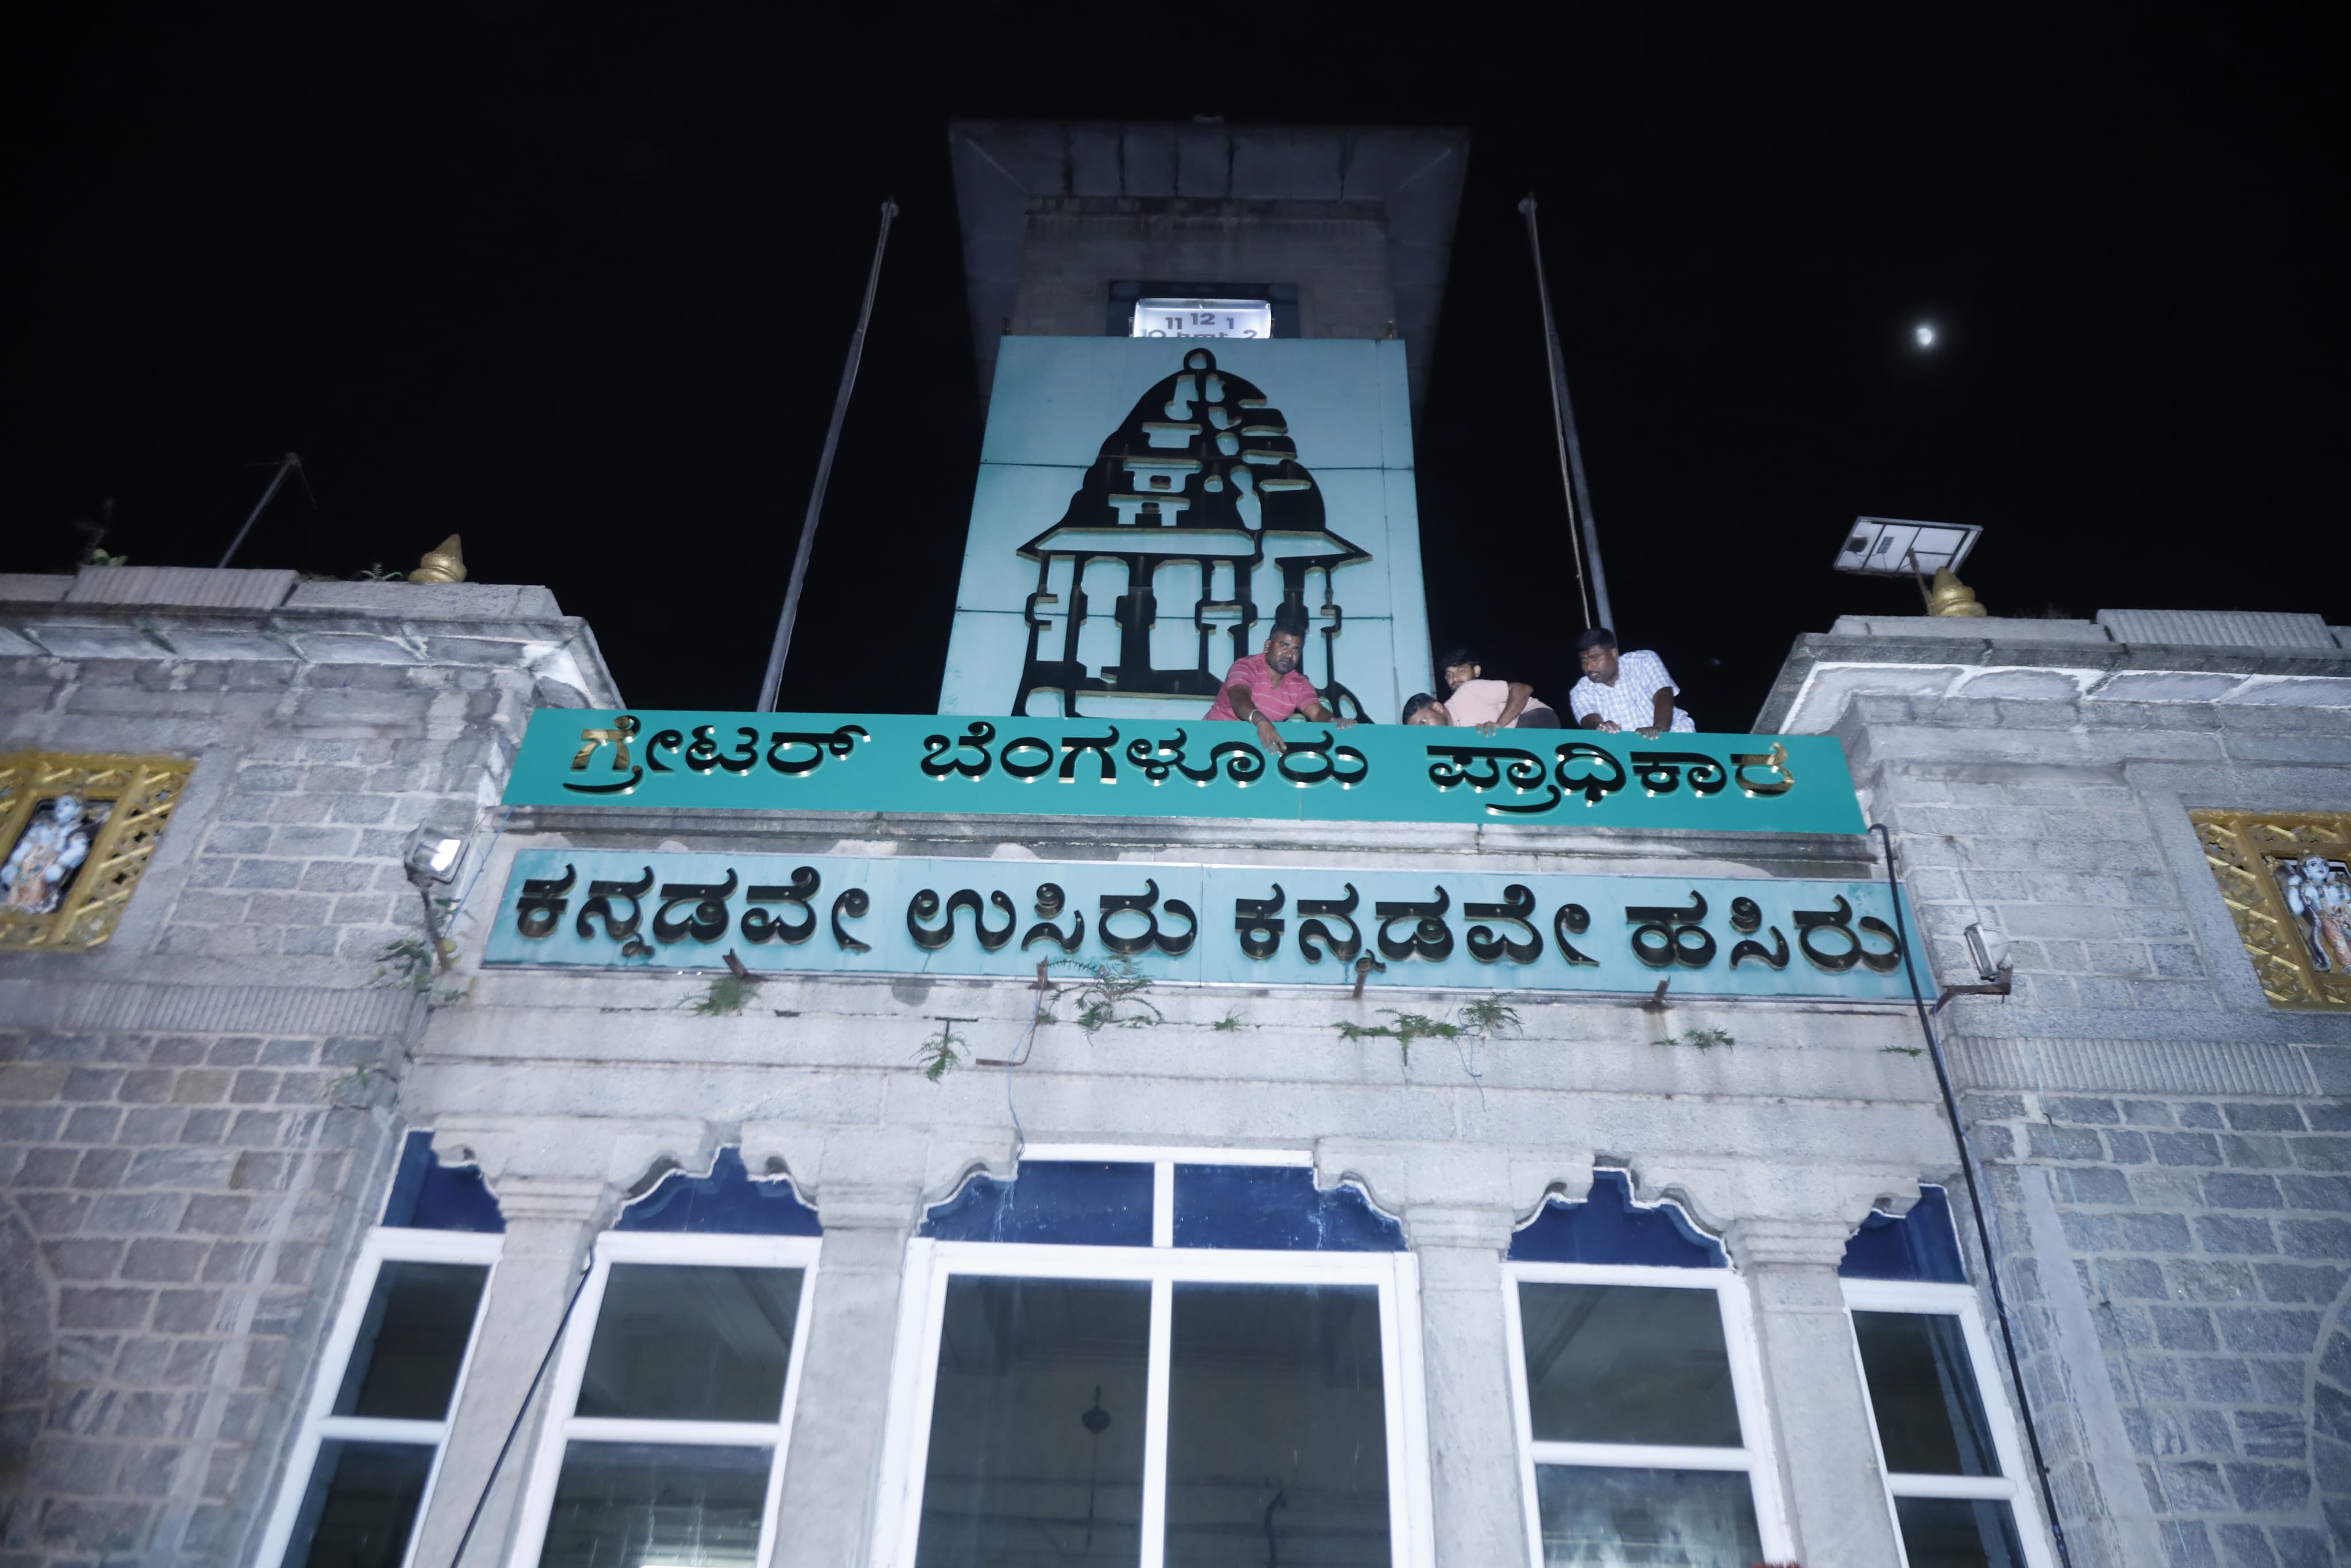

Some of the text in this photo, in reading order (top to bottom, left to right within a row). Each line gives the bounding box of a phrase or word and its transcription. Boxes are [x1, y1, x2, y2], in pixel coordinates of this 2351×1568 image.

[1166, 317, 1182, 330] 11
[1190, 312, 1215, 325] 12
[1226, 317, 1234, 329] 1
[562, 715, 1795, 816] ಗ್ರೇಟರ್ ಬೆಂಗಳೂರು ಪ್ರಾಧಿಕಾರ
[517, 863, 1902, 974] ಕನ್ನಡವೇ ಉಸಿರು ಕನ್ನಡವೇ ಹಸಿರು
